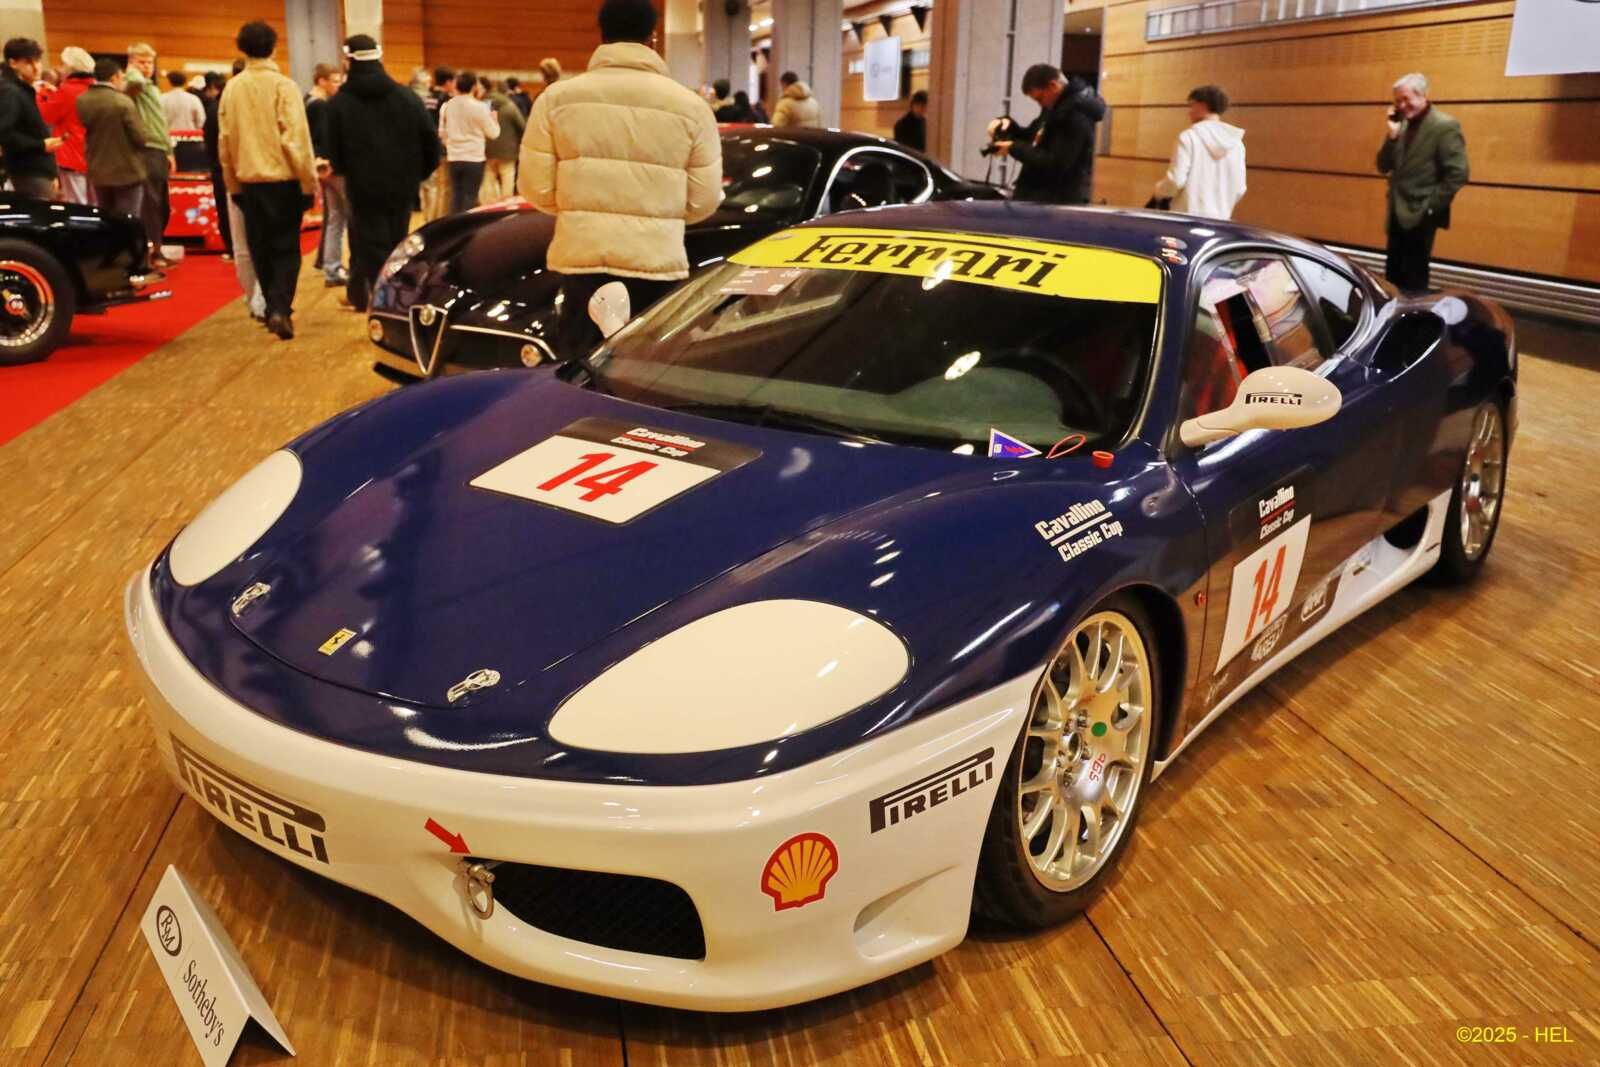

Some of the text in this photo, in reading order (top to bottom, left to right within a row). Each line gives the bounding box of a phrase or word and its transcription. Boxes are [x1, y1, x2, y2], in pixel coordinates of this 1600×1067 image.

[784, 235, 1067, 288] Ferrari
[1245, 391, 1302, 406] PIRELLI
[535, 453, 659, 502] 14
[1034, 499, 1106, 540] Cavallino
[1259, 485, 1295, 518] Cavallino
[1260, 508, 1295, 540] Classic Cup
[1057, 521, 1124, 562] Classic Cup
[1243, 544, 1287, 641] 14
[169, 731, 330, 864] PIRELLI
[869, 746, 995, 834] PIRELLI
[160, 913, 176, 948] RM
[183, 959, 225, 1047] Sotheby's
